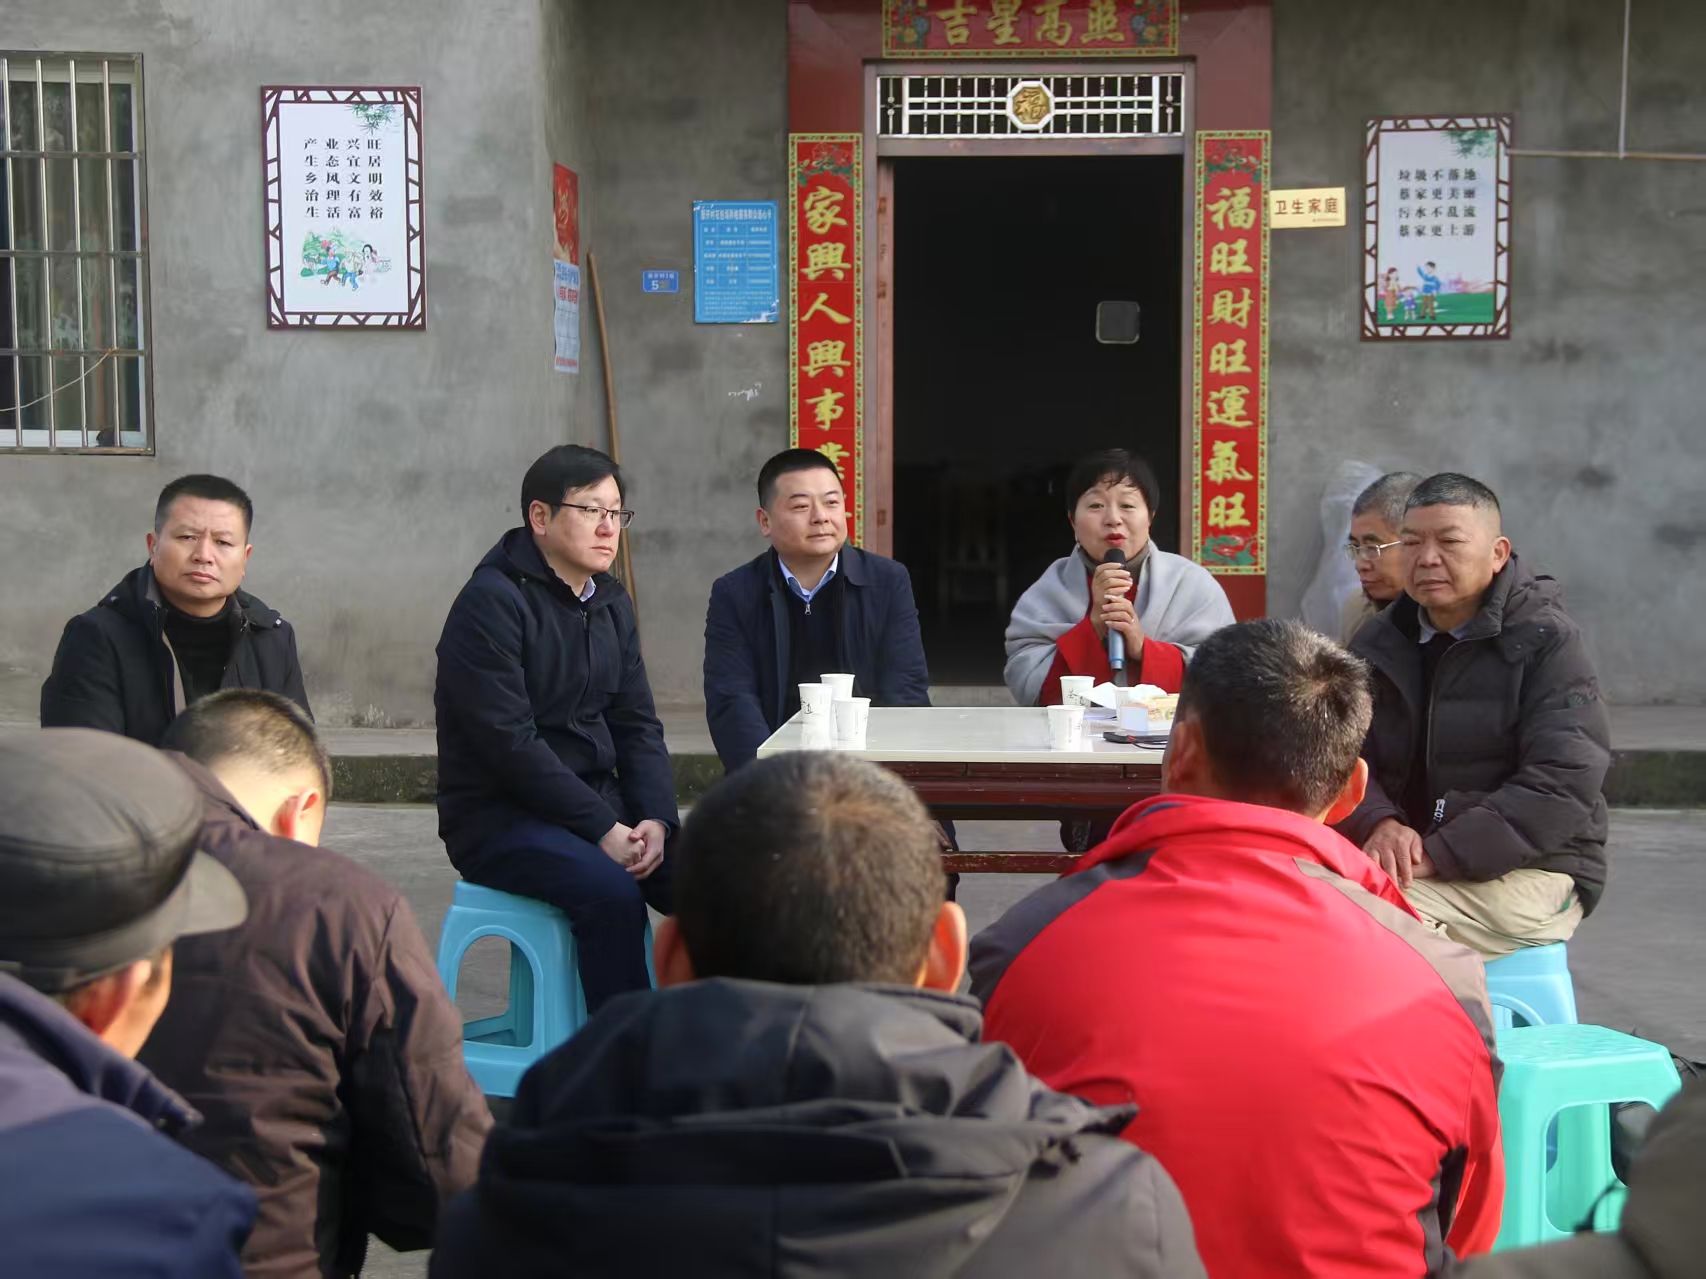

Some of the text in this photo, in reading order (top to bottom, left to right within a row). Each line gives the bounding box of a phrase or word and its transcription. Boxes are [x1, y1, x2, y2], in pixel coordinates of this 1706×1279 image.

[936, 0, 1125, 46] 吉星高照
[304, 138, 382, 150] 产业兴旺
[304, 155, 382, 167] 生态宜居
[304, 172, 383, 184] 乡风文明
[1399, 168, 1477, 181] 垃圾不落地
[304, 189, 383, 201] 治理有效
[1274, 197, 1338, 215] 卫生家庭
[1399, 206, 1477, 218] 污水不乱流
[304, 206, 384, 219] 生活富裕
